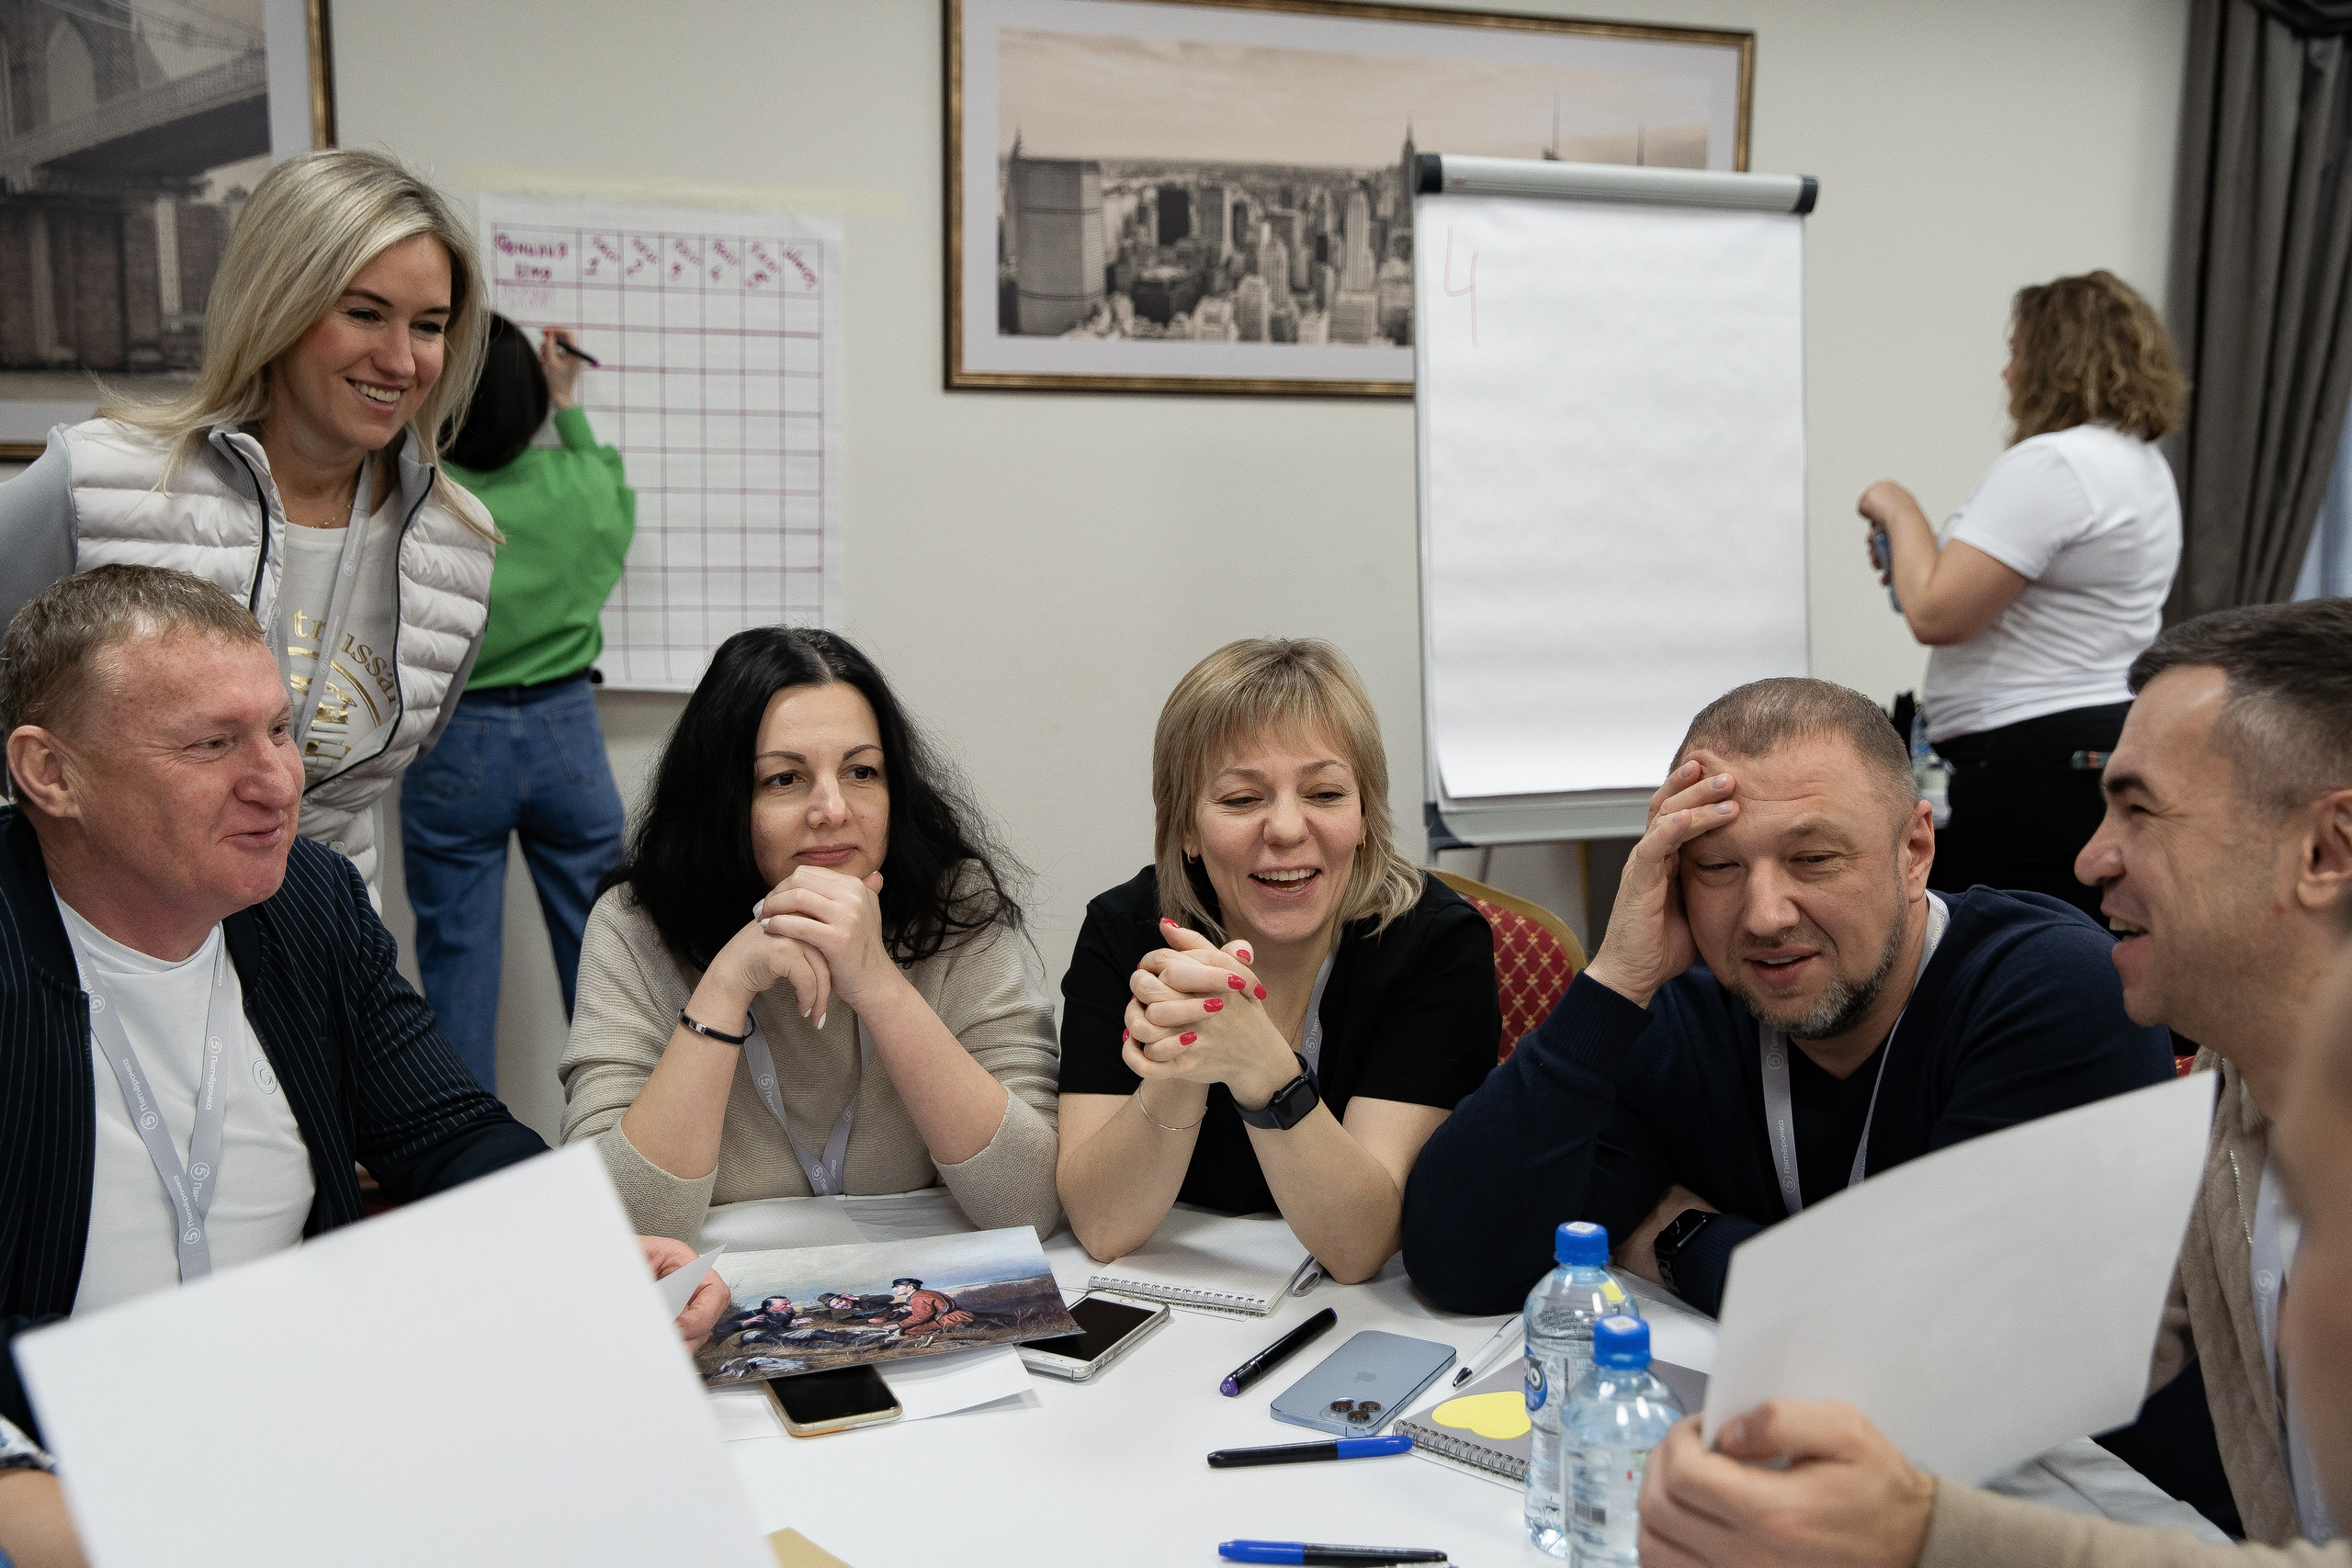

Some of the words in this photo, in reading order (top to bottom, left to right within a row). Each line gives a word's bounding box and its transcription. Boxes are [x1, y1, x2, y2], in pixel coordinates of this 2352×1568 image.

[1443, 226, 1479, 348] 4
[122, 1058, 149, 1111] Пятёрочка
[205, 1055, 218, 1111] Пятёрочка
[1779, 1120, 1791, 1174] Пятёрочка
[173, 1174, 195, 1227] Пятёрочка
